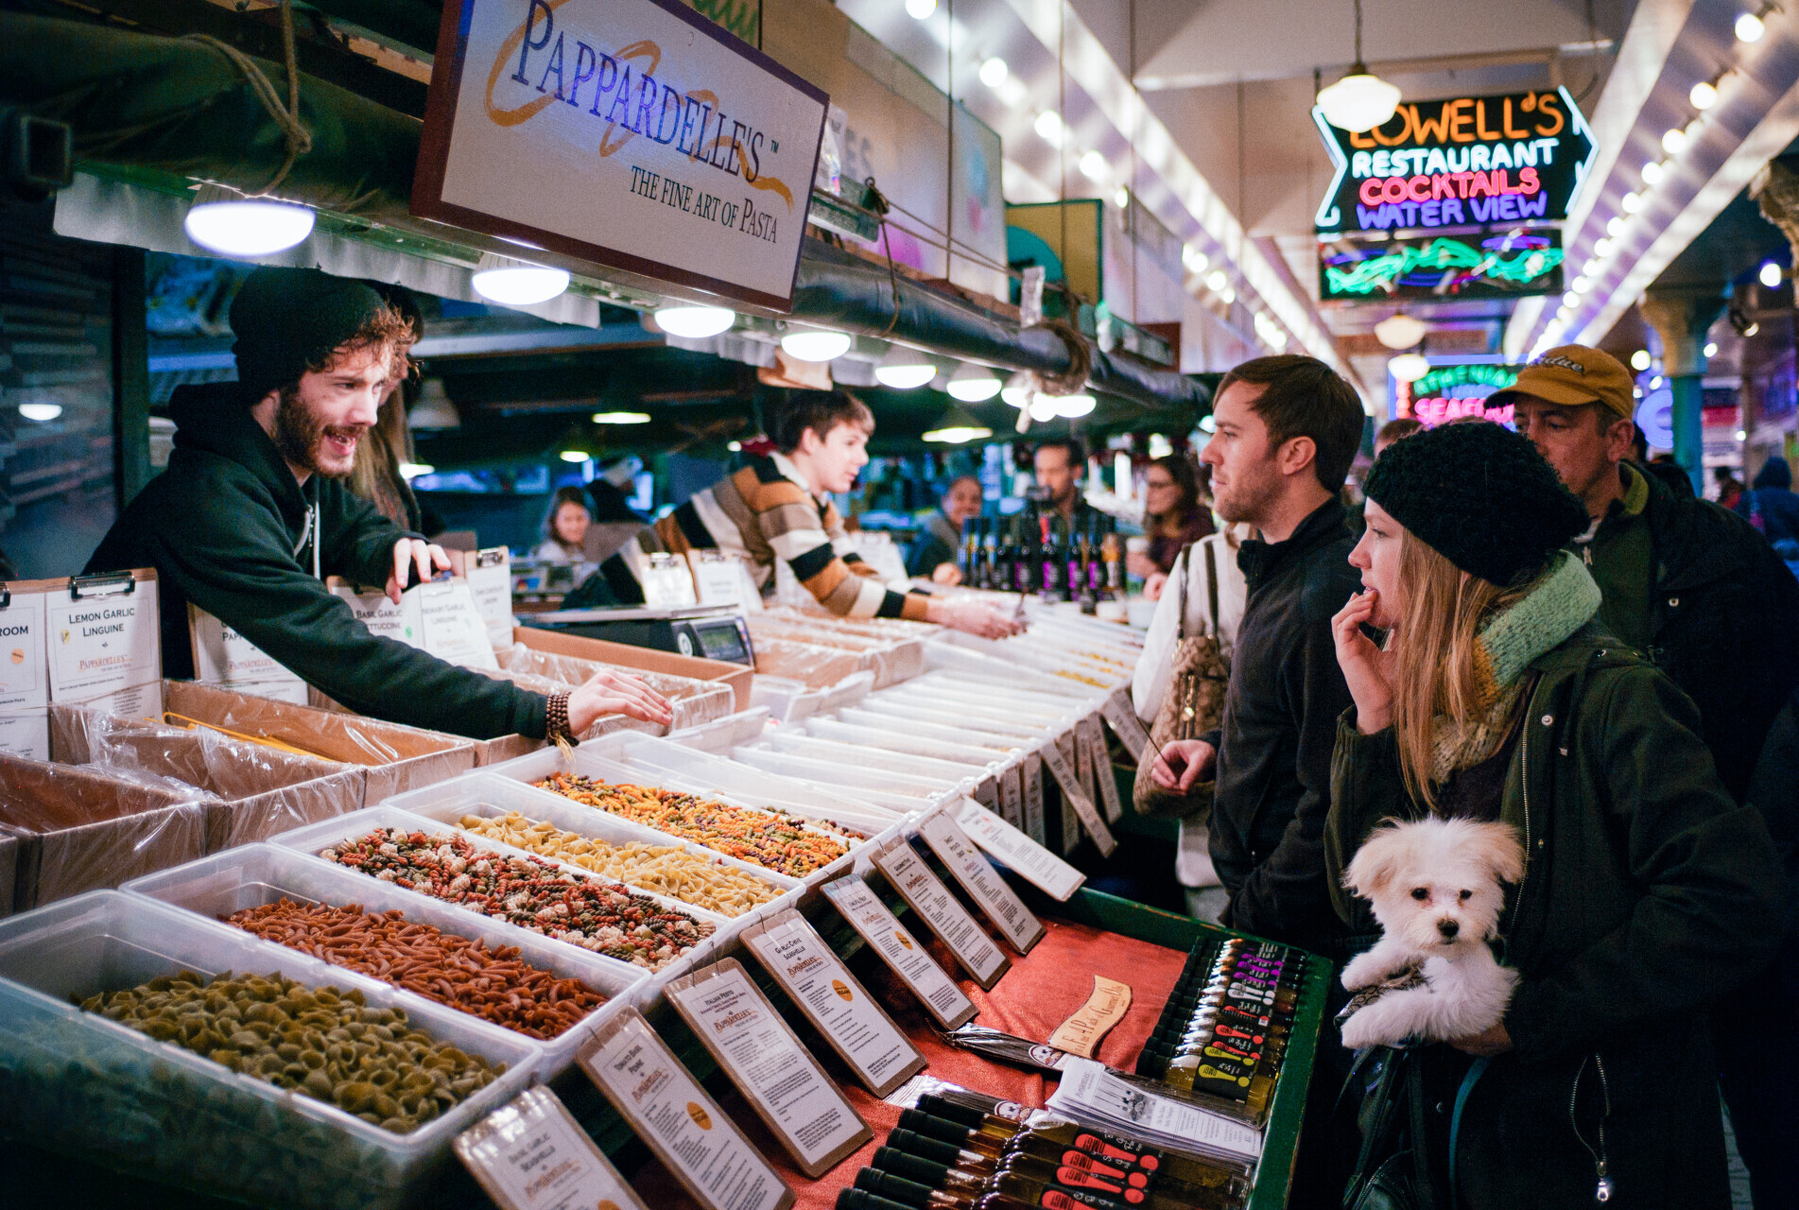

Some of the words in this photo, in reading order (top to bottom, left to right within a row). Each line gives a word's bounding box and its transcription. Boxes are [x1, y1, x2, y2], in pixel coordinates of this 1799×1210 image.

[511, 0, 764, 183] PAPPARDELLE'S
[1352, 137, 1560, 178] RESTAURANT
[630, 165, 659, 201] THE
[663, 178, 693, 217] FINE
[693, 192, 721, 222] ART
[722, 201, 739, 228] OF
[739, 197, 777, 244] PASTA
[1359, 167, 1541, 206] COCKTAILS
[1356, 196, 1465, 230] WATER
[1469, 190, 1548, 222] VIEW
[68, 612, 101, 624] LEMON
[103, 607, 135, 620] GARLIC
[82, 623, 124, 637] LINGUINE
[378, 609, 402, 618] GARLIC
